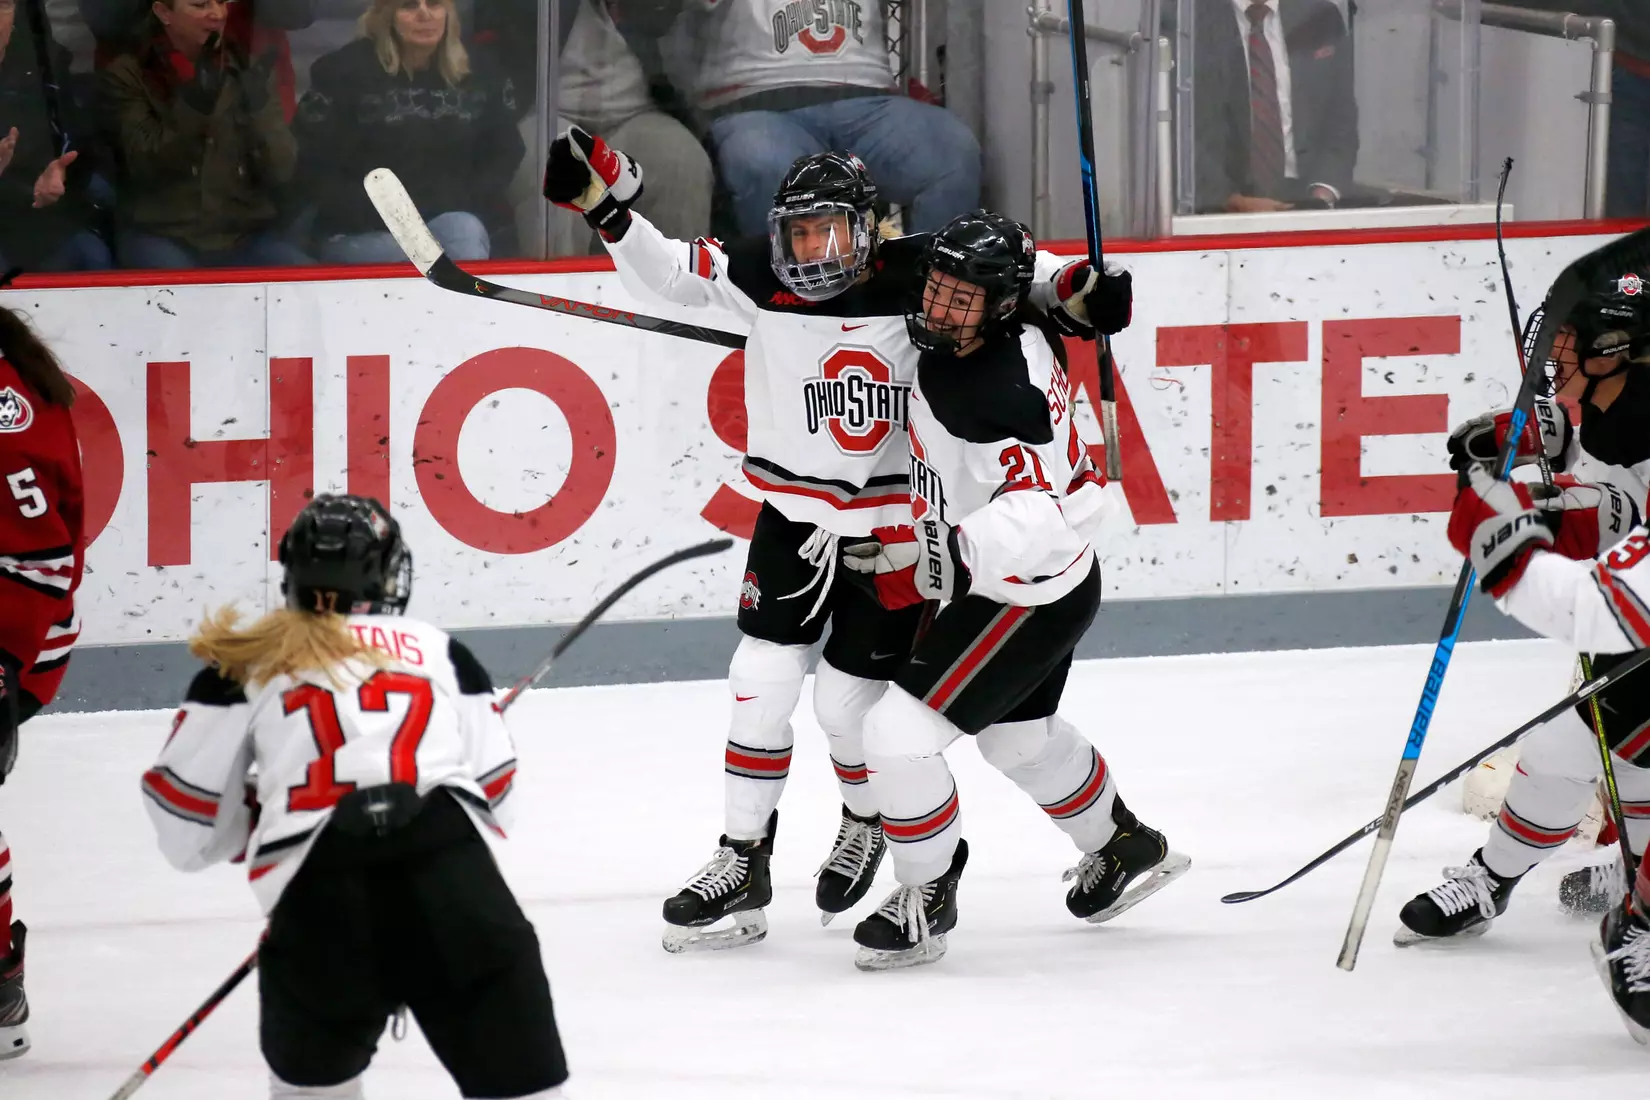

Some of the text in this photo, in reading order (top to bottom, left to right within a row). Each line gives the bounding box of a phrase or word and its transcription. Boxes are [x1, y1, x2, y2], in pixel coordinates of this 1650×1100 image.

[785, 193, 815, 203] BAUER
[937, 245, 965, 260] BAUER
[540, 294, 639, 328] VAPOR
[803, 381, 846, 435] OHIO
[1047, 356, 1069, 426] SCHE
[1535, 398, 1557, 437] UER
[62, 346, 617, 566] HIO
[999, 443, 1053, 491] 21
[6, 466, 48, 518] 5
[1481, 512, 1546, 559] UER
[348, 624, 424, 665] TAIS
[1407, 660, 1447, 749] BAUER
[279, 669, 435, 813] 17
[1382, 769, 1409, 831] NEXUS
